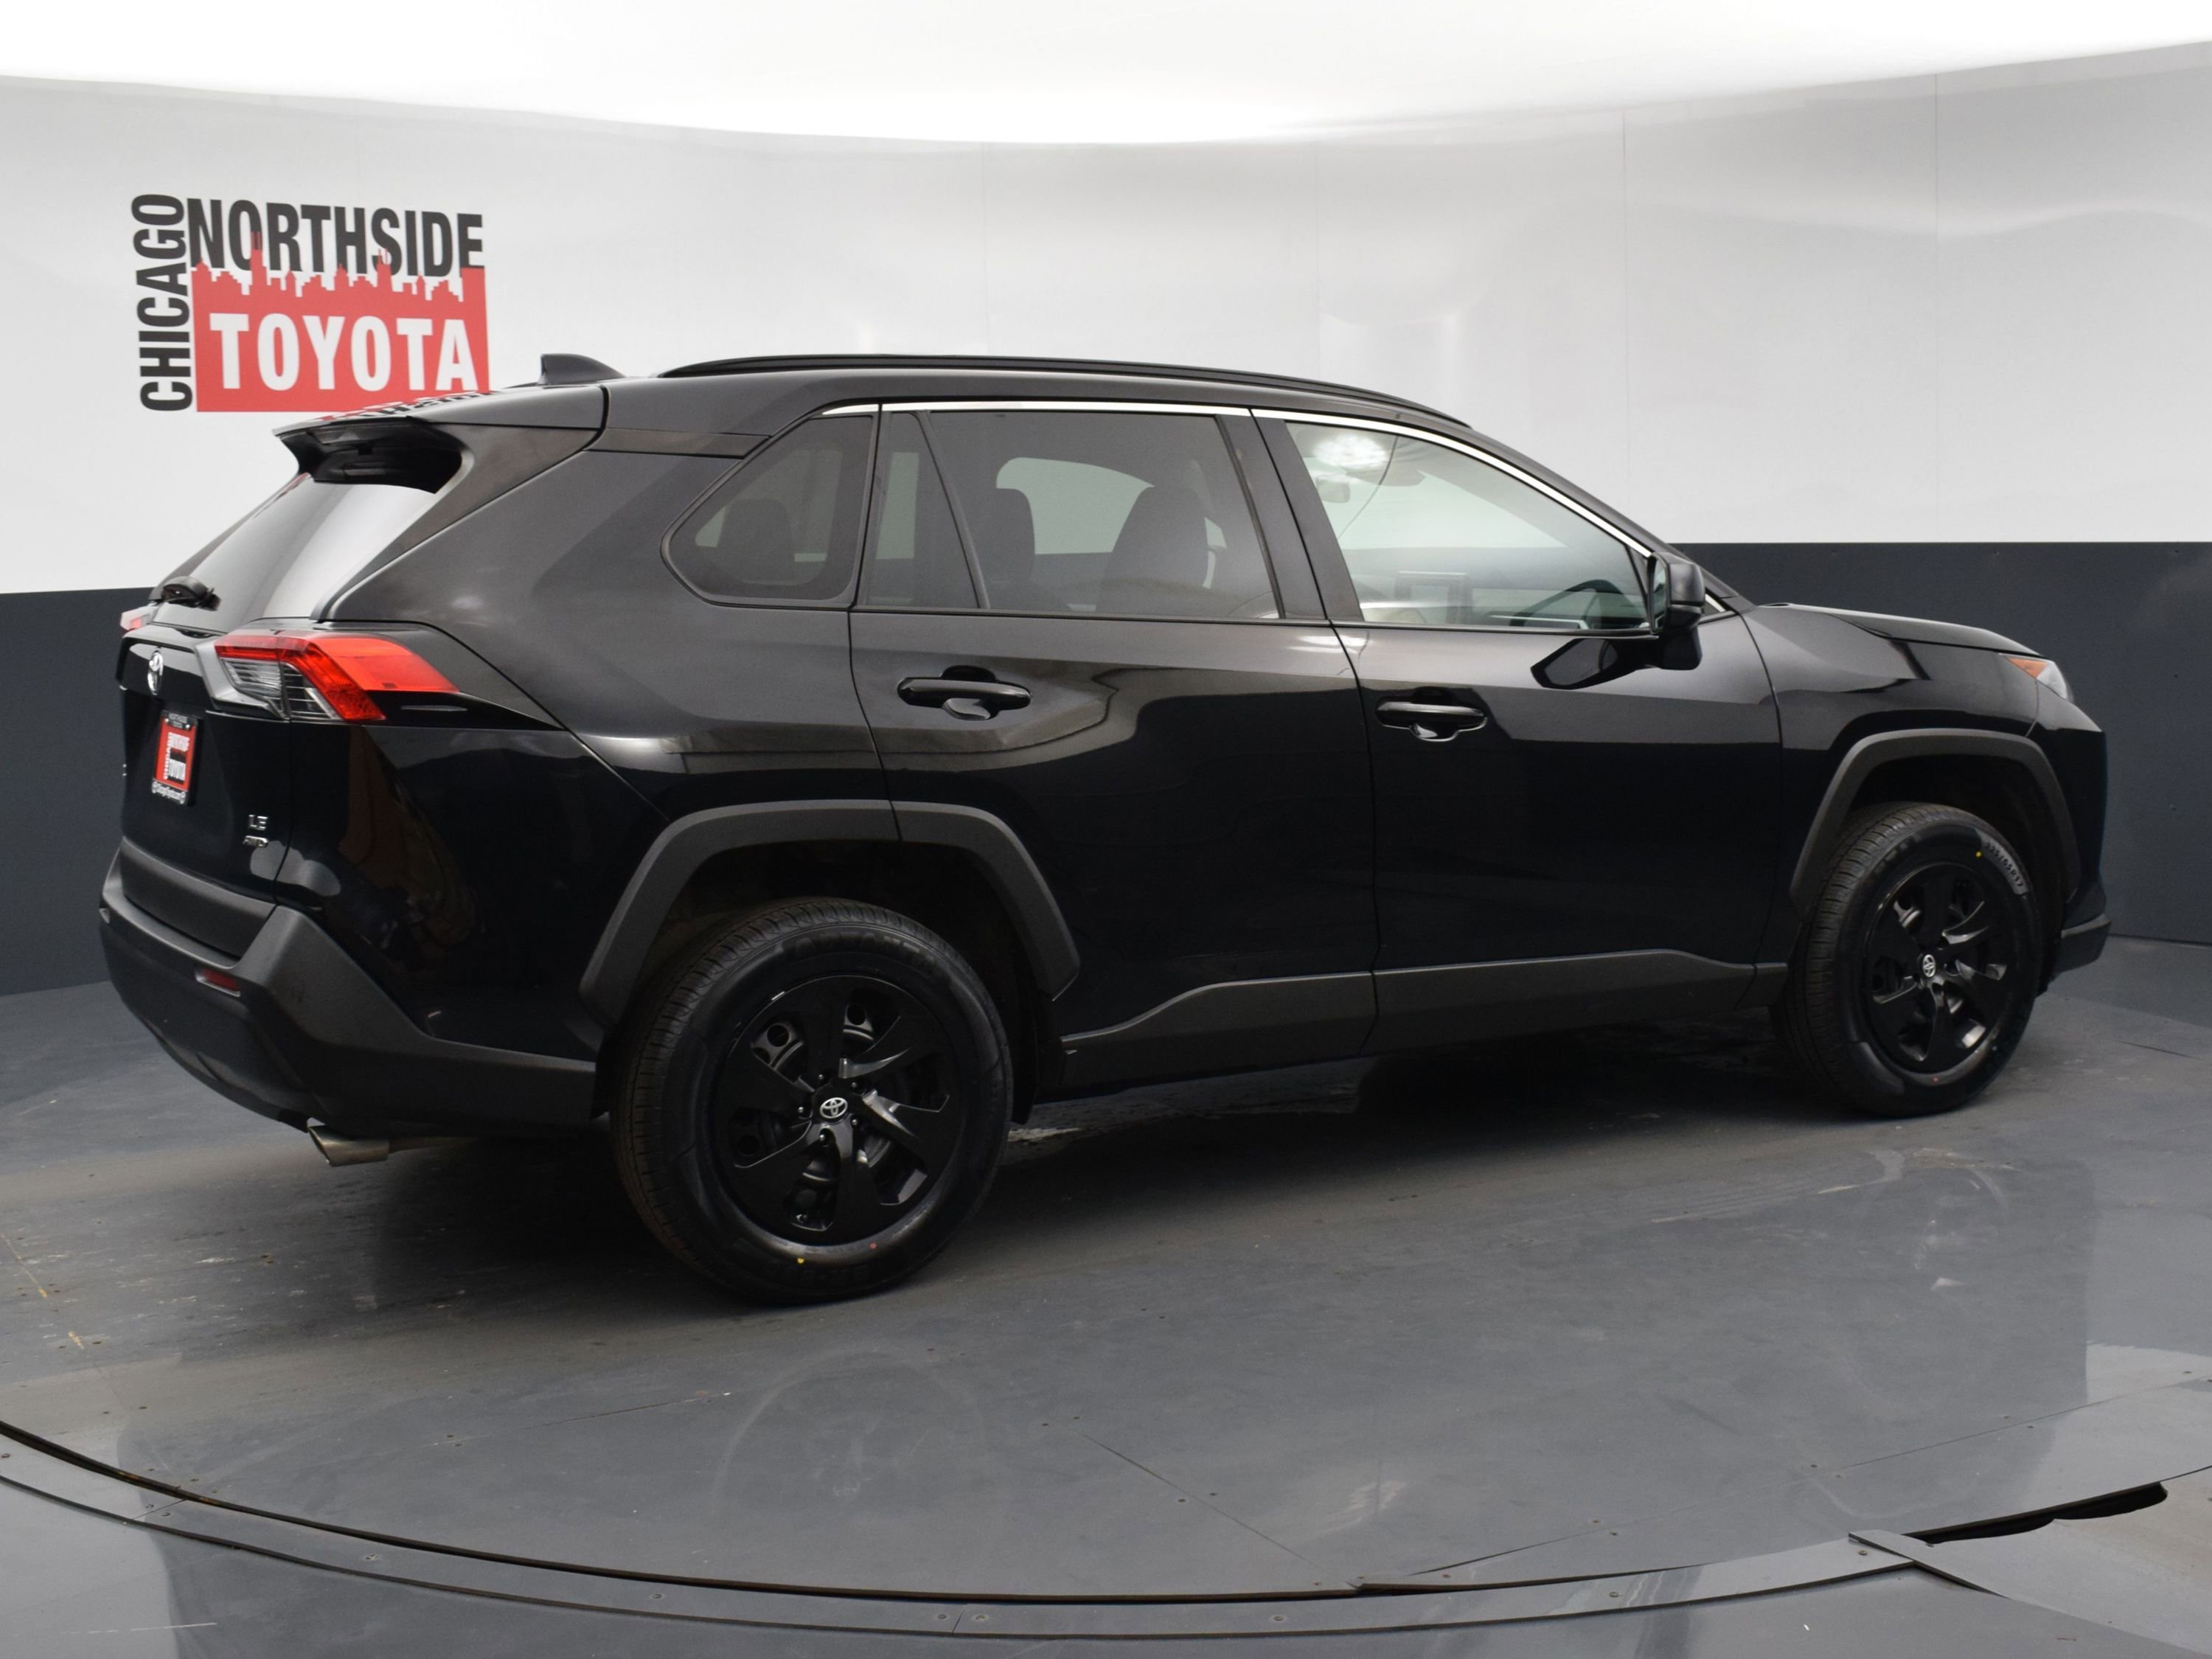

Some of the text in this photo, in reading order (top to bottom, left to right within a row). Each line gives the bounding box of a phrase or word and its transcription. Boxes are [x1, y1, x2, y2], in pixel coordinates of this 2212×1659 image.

[187, 198, 484, 277] NORTHSIDE
[131, 194, 192, 411] CHICAGO
[209, 313, 479, 391] TOYOTA
[248, 814, 268, 830] LE
